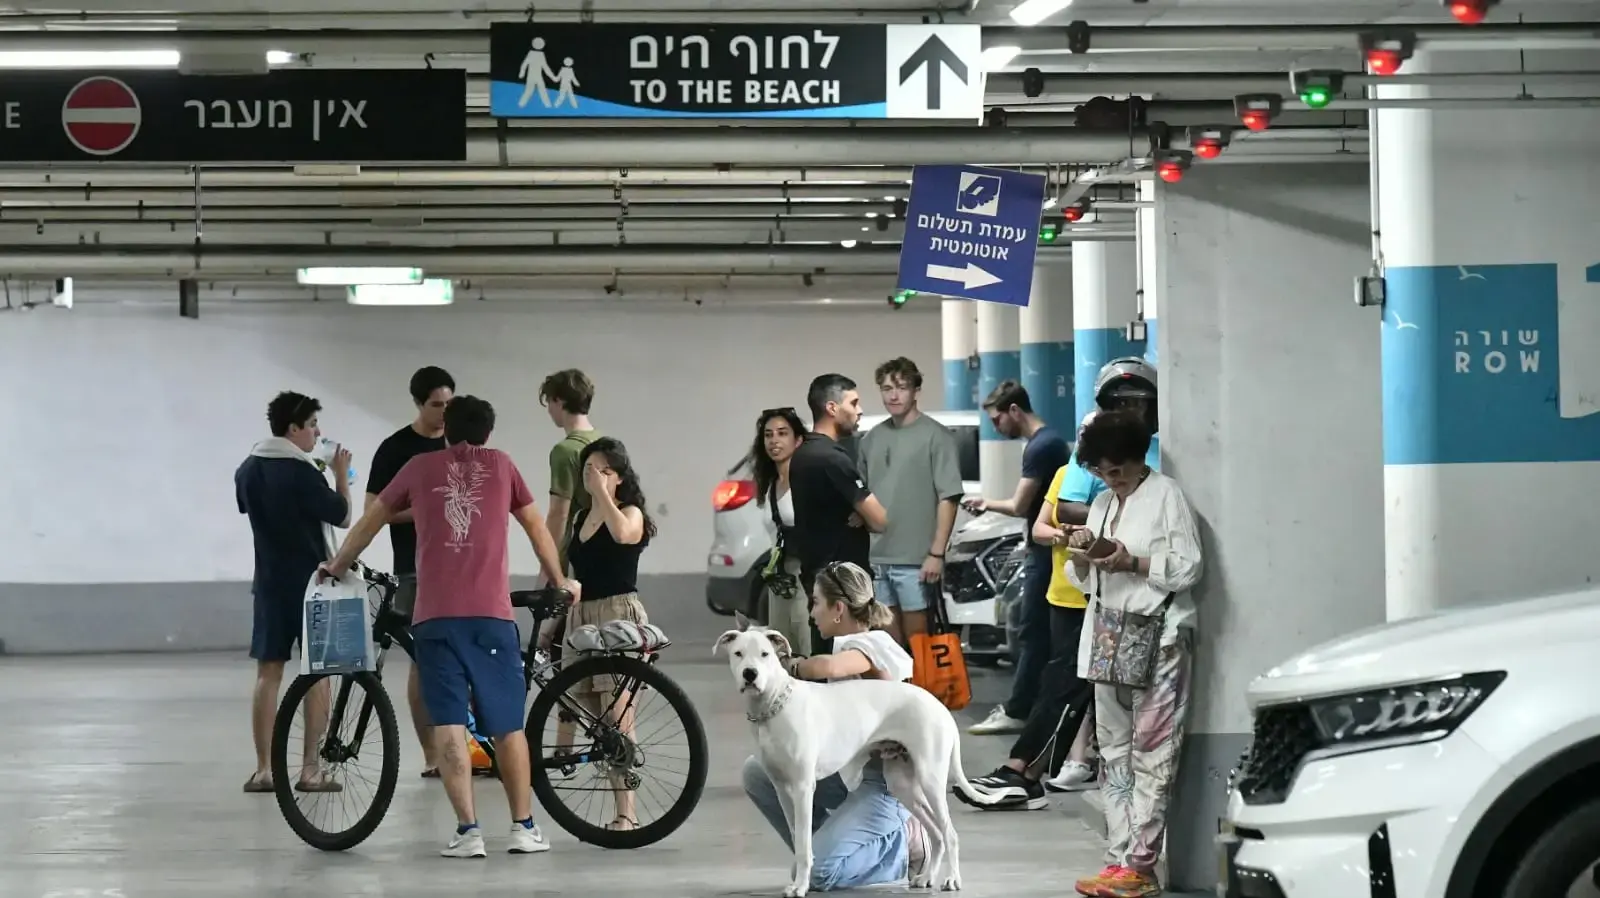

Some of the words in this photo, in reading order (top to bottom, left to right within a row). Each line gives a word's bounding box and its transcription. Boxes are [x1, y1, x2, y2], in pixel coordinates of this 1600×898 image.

[629, 35, 710, 69] הים
[729, 30, 841, 74] לחוף
[630, 79, 667, 103] TO
[678, 79, 732, 103] THE
[744, 79, 840, 104] BEACH
[184, 99, 292, 129] מעבר
[313, 99, 368, 141] אין
[917, 213, 973, 234] תשלום
[979, 222, 1027, 243] עמדת
[929, 236, 1009, 261] אוטומטית
[1455, 329, 1539, 346] שורה
[1455, 350, 1540, 374] ROW
